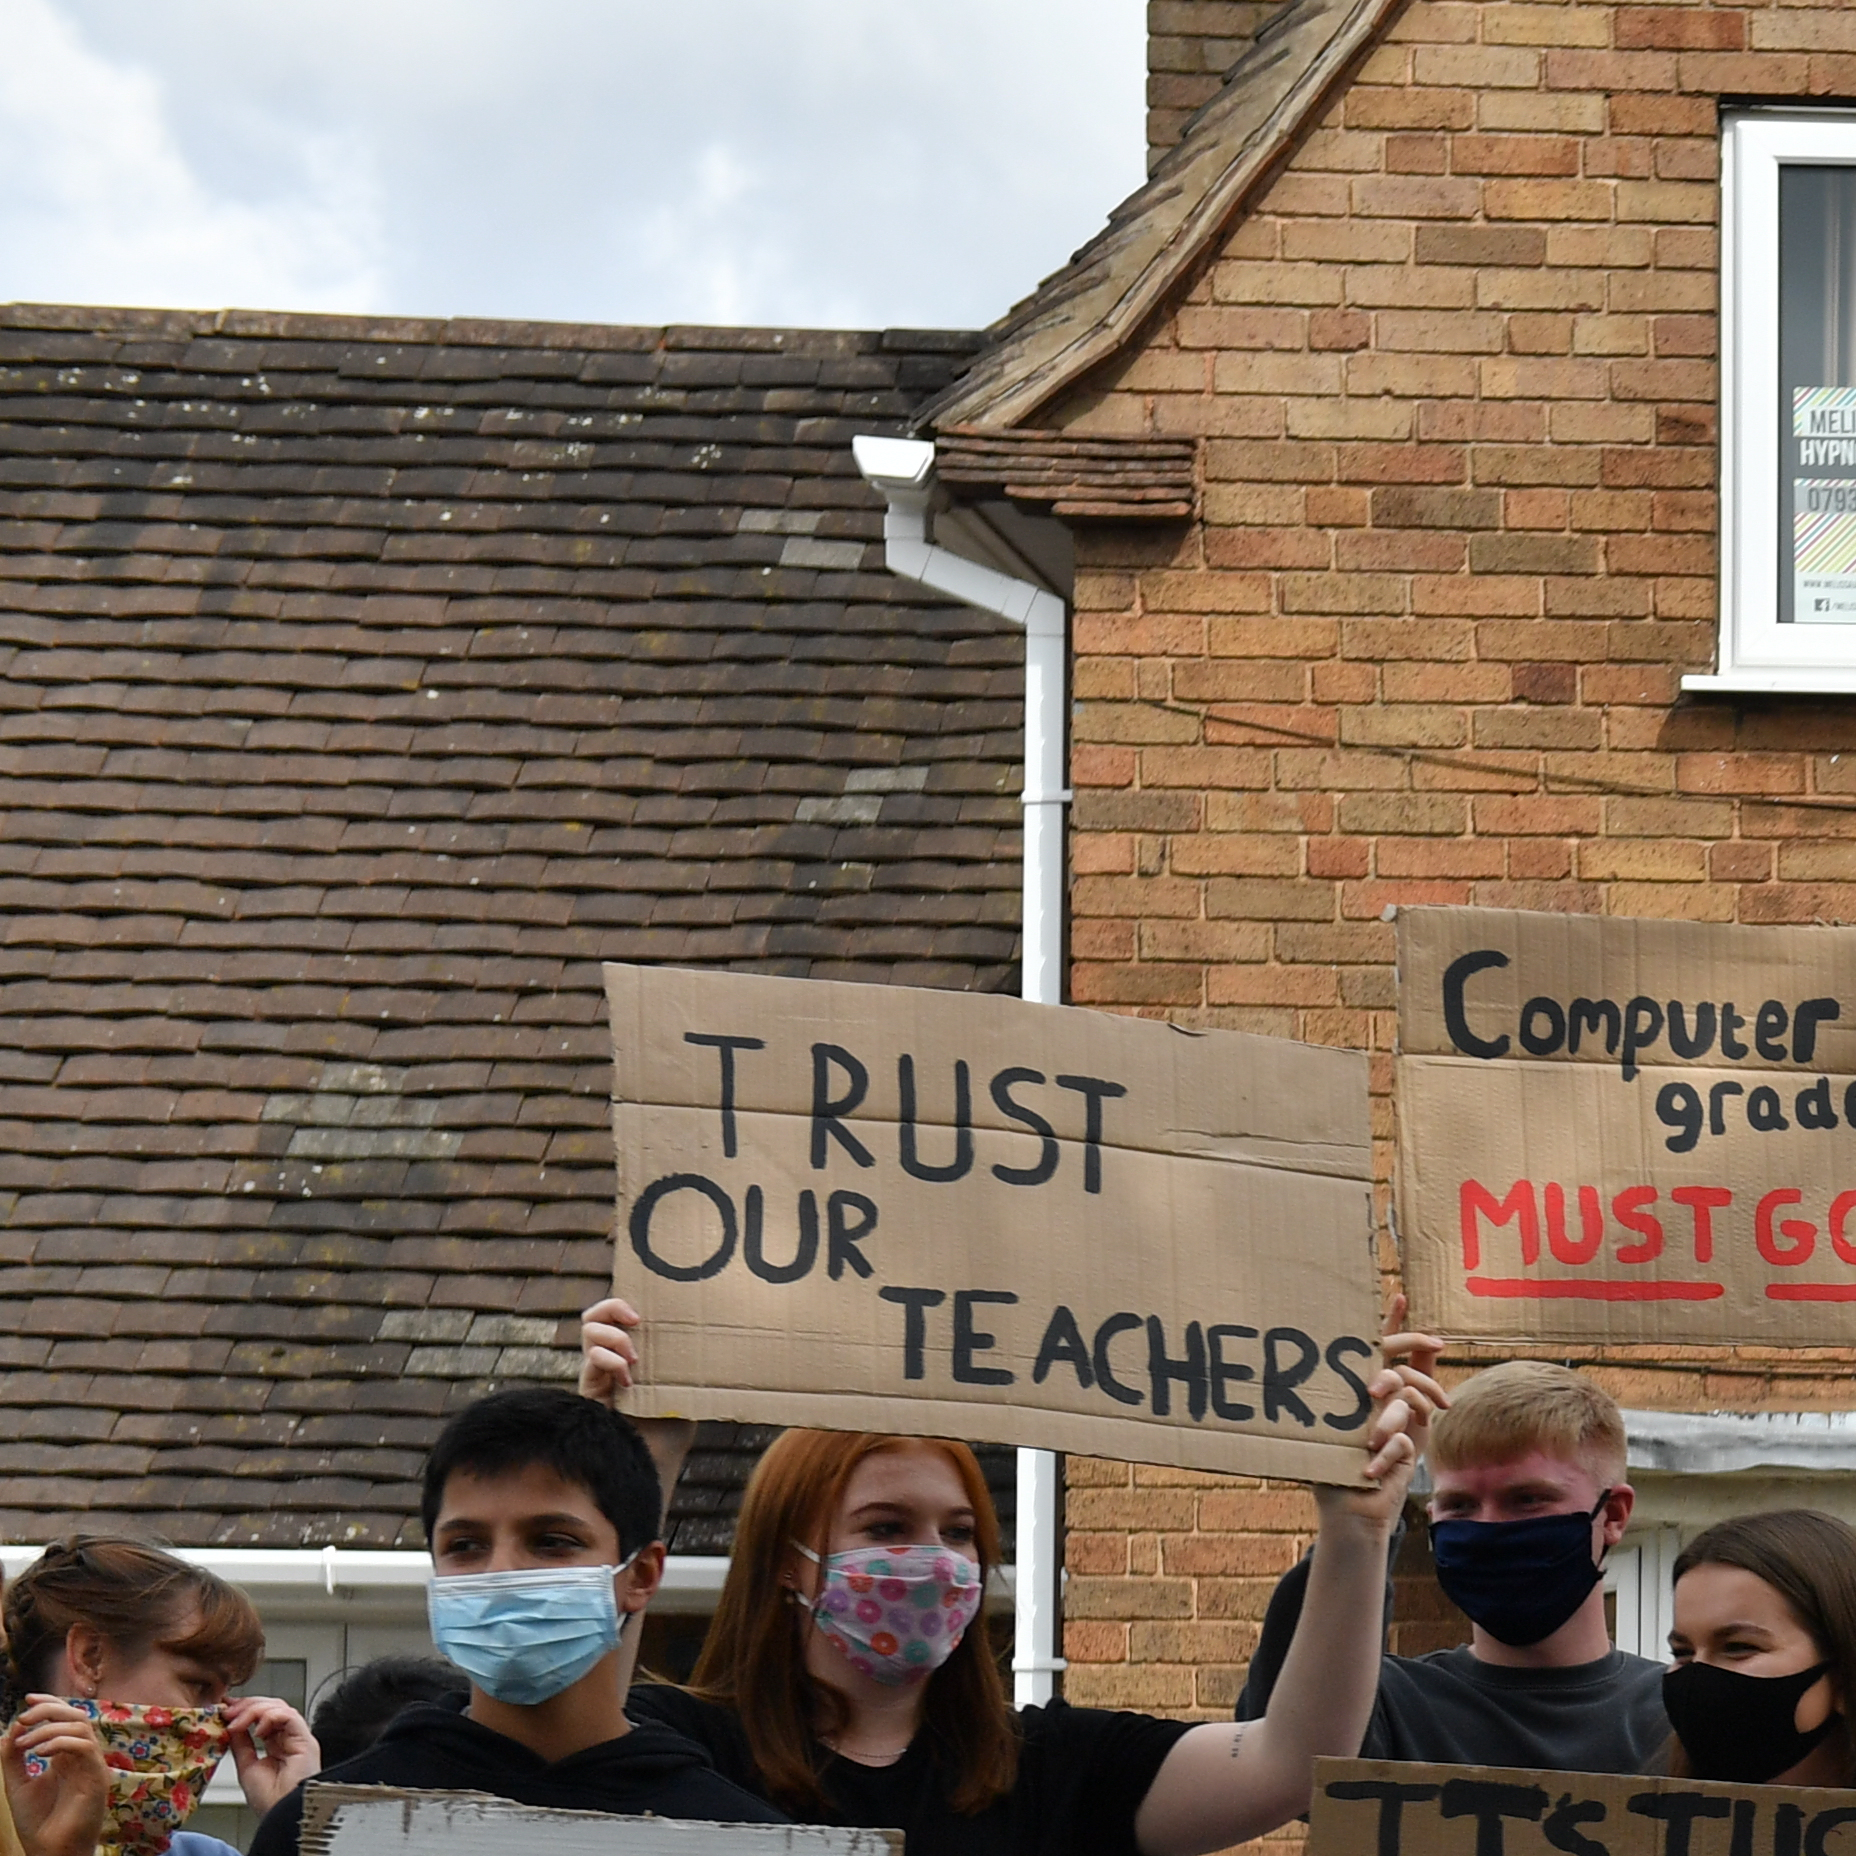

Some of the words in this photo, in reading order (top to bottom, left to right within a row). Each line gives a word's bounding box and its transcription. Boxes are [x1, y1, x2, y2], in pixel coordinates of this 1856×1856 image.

[1442, 950, 1840, 1082] Computer
[684, 1032, 1127, 1194] TRUST
[629, 1172, 879, 1284] OUR
[1460, 1179, 1732, 1270] MUST
[879, 1286, 1374, 1431] TEACHERS
